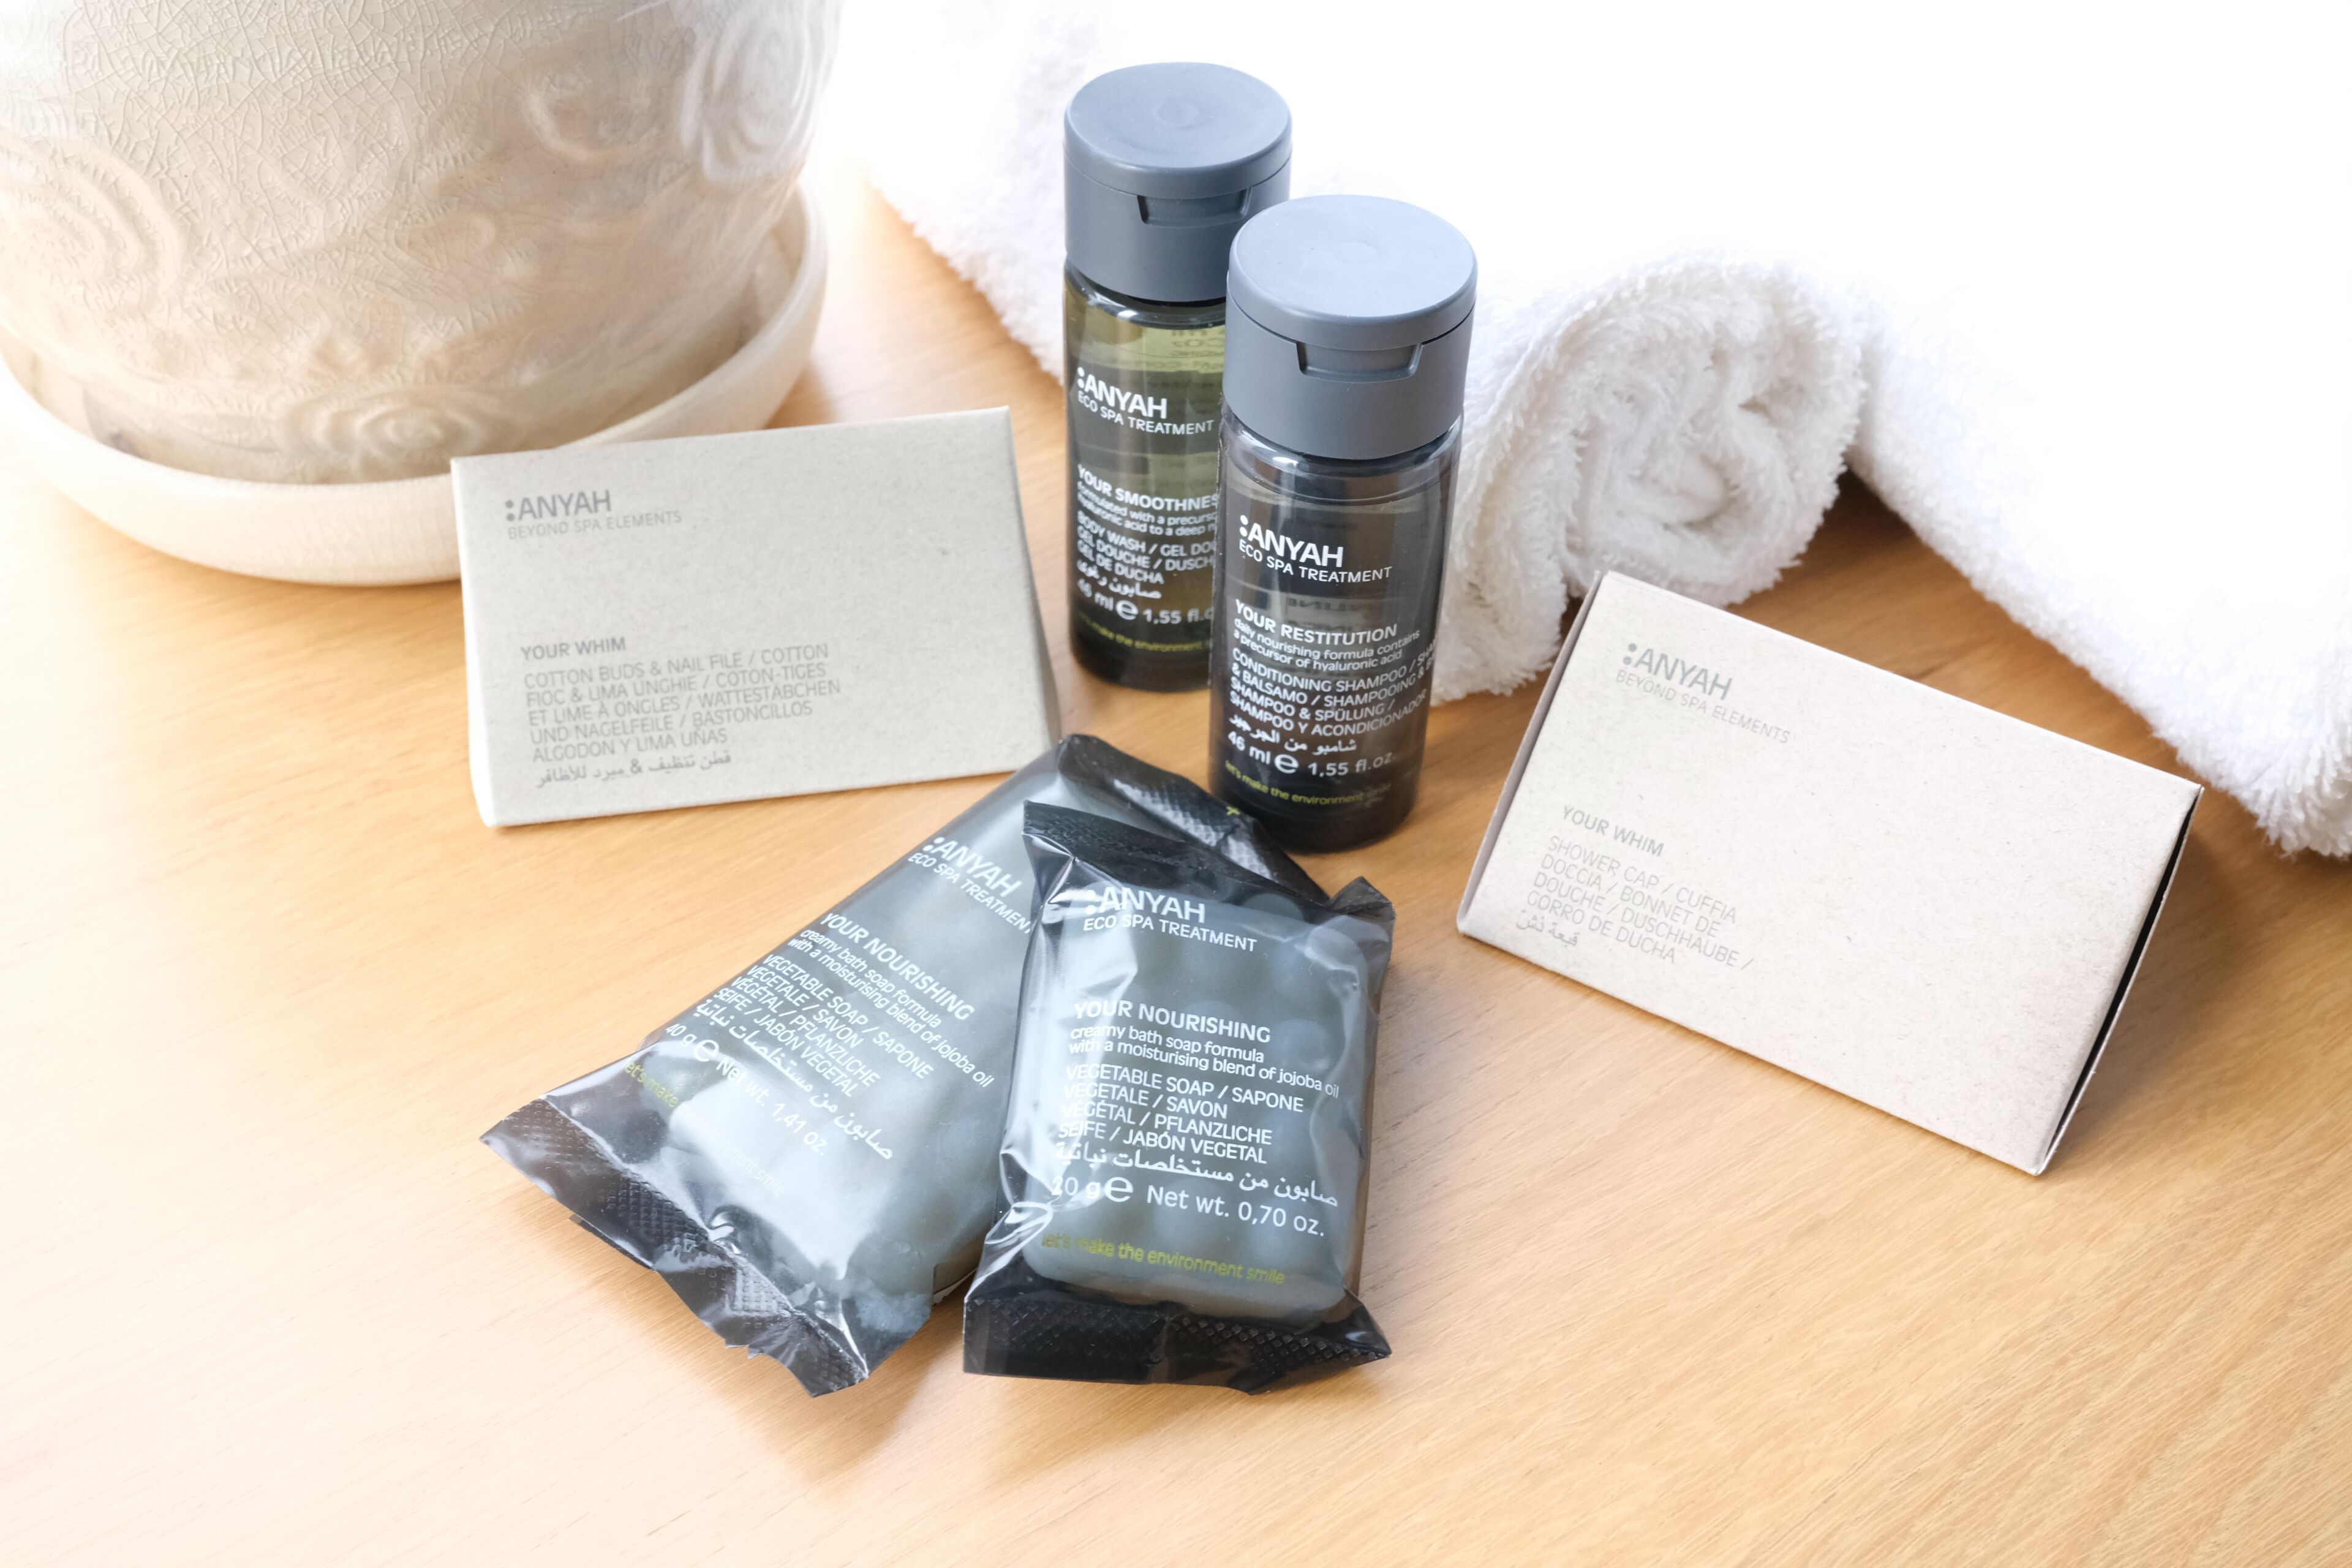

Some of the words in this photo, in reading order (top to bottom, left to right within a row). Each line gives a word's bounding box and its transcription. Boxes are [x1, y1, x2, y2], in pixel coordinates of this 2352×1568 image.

[1078, 391, 1098, 412] ECO
[1100, 405, 1124, 426] SPA
[1128, 415, 1215, 435] TREATMENT
[1078, 464, 1112, 497] YOUR
[508, 522, 568, 540] BEYOND
[574, 519, 601, 533] SPA
[606, 510, 682, 529] ELEMENTS
[1129, 511, 1155, 523] with
[1157, 516, 1164, 525] a
[1149, 525, 1163, 535] to
[1165, 527, 1173, 536] a
[1175, 524, 1204, 537] deep
[1096, 539, 1150, 569] DOUCHE
[1107, 530, 1146, 553] WASH
[1160, 543, 1186, 557] GEL
[1239, 539, 1262, 562] ECO
[1267, 556, 1293, 575] SPA
[1298, 566, 1392, 582] TREATMENT
[1096, 553, 1112, 571] DE
[1115, 564, 1164, 584] DUCHA
[1234, 618, 1256, 639] daily
[1257, 633, 1321, 660] nourishing
[1324, 649, 1374, 661] formula
[1235, 599, 1276, 633] YOUR
[1281, 624, 1397, 646] RESTITUTION
[521, 643, 569, 660] YOUR
[575, 637, 625, 655] WHIM
[524, 668, 593, 689] COTTON
[598, 662, 644, 681] BUDS
[650, 661, 661, 676] &
[668, 657, 704, 673] NAIL
[709, 652, 742, 669] FILE
[761, 643, 828, 665] COTTON
[1232, 648, 1332, 692] CONDITIONING
[1336, 664, 1407, 692] SHAMPOO
[1240, 635, 1294, 664] precursor
[1295, 657, 1310, 668] of
[1313, 658, 1378, 673] hyaluronic
[1381, 649, 1402, 665] acid
[526, 689, 565, 707] FIOC
[571, 687, 582, 703] &
[589, 684, 628, 701] LIMA
[1231, 677, 1295, 717] SHAMPOO
[1298, 709, 1311, 720] &
[1314, 703, 1385, 722] SPÜLUNG
[1242, 670, 1307, 706] BALSAMO
[1324, 673, 1415, 707] SHAMPOOING
[1616, 669, 1677, 701] BEYOND
[1681, 693, 1706, 714] SPA
[1712, 705, 1790, 744] ELEMENTS
[529, 710, 546, 726] ET
[554, 706, 591, 724] LIME
[614, 696, 680, 717] ONGLES
[530, 726, 569, 744] UND
[575, 715, 673, 739] NAGELFEILE
[693, 701, 813, 729] BASTONCILLOS
[1230, 692, 1295, 731] SHAMPOO
[1298, 722, 1310, 734] Y
[1311, 688, 1426, 737] ACONDICIONADOR
[620, 739, 630, 753] Y
[636, 734, 676, 752] LIMA
[1249, 745, 1271, 764] ml
[1308, 762, 1348, 777] 1,55
[1284, 737, 1307, 752] من
[1564, 805, 1609, 835] YOUR
[1614, 826, 1664, 856] WHIM
[908, 852, 936, 867] ECO
[933, 864, 960, 883] SPA
[1548, 835, 1621, 876] SHOWER
[1624, 866, 1659, 888] CAP
[1676, 887, 1736, 924] CUFFIA
[1534, 872, 1605, 912] DOUCHE
[1541, 853, 1601, 891] DOCCIA
[1620, 886, 1693, 924] BONNET
[1695, 916, 1721, 937] DE
[1083, 916, 1117, 932] ECO
[1123, 914, 1153, 930] SPA
[1159, 919, 1257, 951] TREATMENT
[1588, 915, 1613, 937] DE
[1615, 926, 1675, 964] DUCHA
[801, 930, 842, 952] creamy
[838, 948, 867, 971] bath
[865, 970, 895, 992] soap
[893, 989, 941, 1027] formula
[821, 914, 869, 943] YOUR
[863, 938, 974, 1020] NOURISHING
[748, 966, 809, 1006] VEGETALE
[813, 1009, 863, 1048] SAVON
[764, 955, 833, 1001] VEGETABLE
[827, 997, 868, 1024] SOAP
[873, 1031, 934, 1079] SAPONE
[788, 940, 812, 952] with
[818, 955, 889, 1008] moisturising
[886, 1003, 925, 1033] blend
[921, 1031, 941, 1043] of
[932, 1040, 975, 1073] jojoba
[973, 1072, 994, 1087] oil
[1075, 998, 1133, 1018] YOUR
[1139, 1004, 1270, 1042] NOURISHING
[666, 1024, 686, 1036] 40
[676, 1034, 696, 1049] g
[717, 1057, 748, 1082] Net
[714, 989, 752, 1011] SEIFE
[754, 1015, 804, 1050] JABÓN
[801, 1046, 869, 1097] VEGETAL
[732, 978, 783, 1012] VÉGÉTAL
[782, 1015, 880, 1086] PFLANZLICHE
[1071, 1025, 1126, 1047] creamy
[1129, 1026, 1162, 1045] bath
[1166, 1037, 1201, 1054] soap
[1205, 1041, 1264, 1063] formula
[1069, 1033, 1103, 1059] with
[1104, 1041, 1113, 1051] a
[1118, 1042, 1208, 1071] moisturising
[1213, 1058, 1255, 1077] blend
[1259, 1067, 1276, 1079] of
[1277, 1069, 1322, 1090] jojoba
[1325, 1084, 1339, 1098] oil
[809, 1093, 838, 1112] من
[1065, 1082, 1149, 1106] VEGETALE
[1167, 1096, 1227, 1118] SAVON
[1066, 1063, 1162, 1093] VEGETABLE
[1167, 1077, 1214, 1096] SOAP
[1232, 1087, 1303, 1112] SAPONE
[834, 1113, 892, 1159] صابون
[1059, 1120, 1106, 1142] SEIFE
[1123, 1129, 1185, 1151] JABÓN
[1191, 1139, 1267, 1164] VEGETAL
[1062, 1099, 1136, 1125] VÉGÉTAL
[1155, 1114, 1272, 1145] PFLANZLICHE
[1113, 1150, 1234, 1182] مستخلصات
[1239, 1173, 1268, 1191] من
[1050, 1173, 1078, 1200] 20
[1084, 1185, 1105, 1204] g
[1147, 1185, 1189, 1209] Net
[1196, 1196, 1229, 1217] wt.
[1238, 1202, 1286, 1227] 0,70
[1294, 1216, 1324, 1236] oz.
[1274, 1177, 1338, 1207] صابون
[1075, 1235, 1115, 1257] make
[1118, 1243, 1144, 1262] the
[1148, 1250, 1243, 1278] environment
[1246, 1268, 1285, 1284] smile
